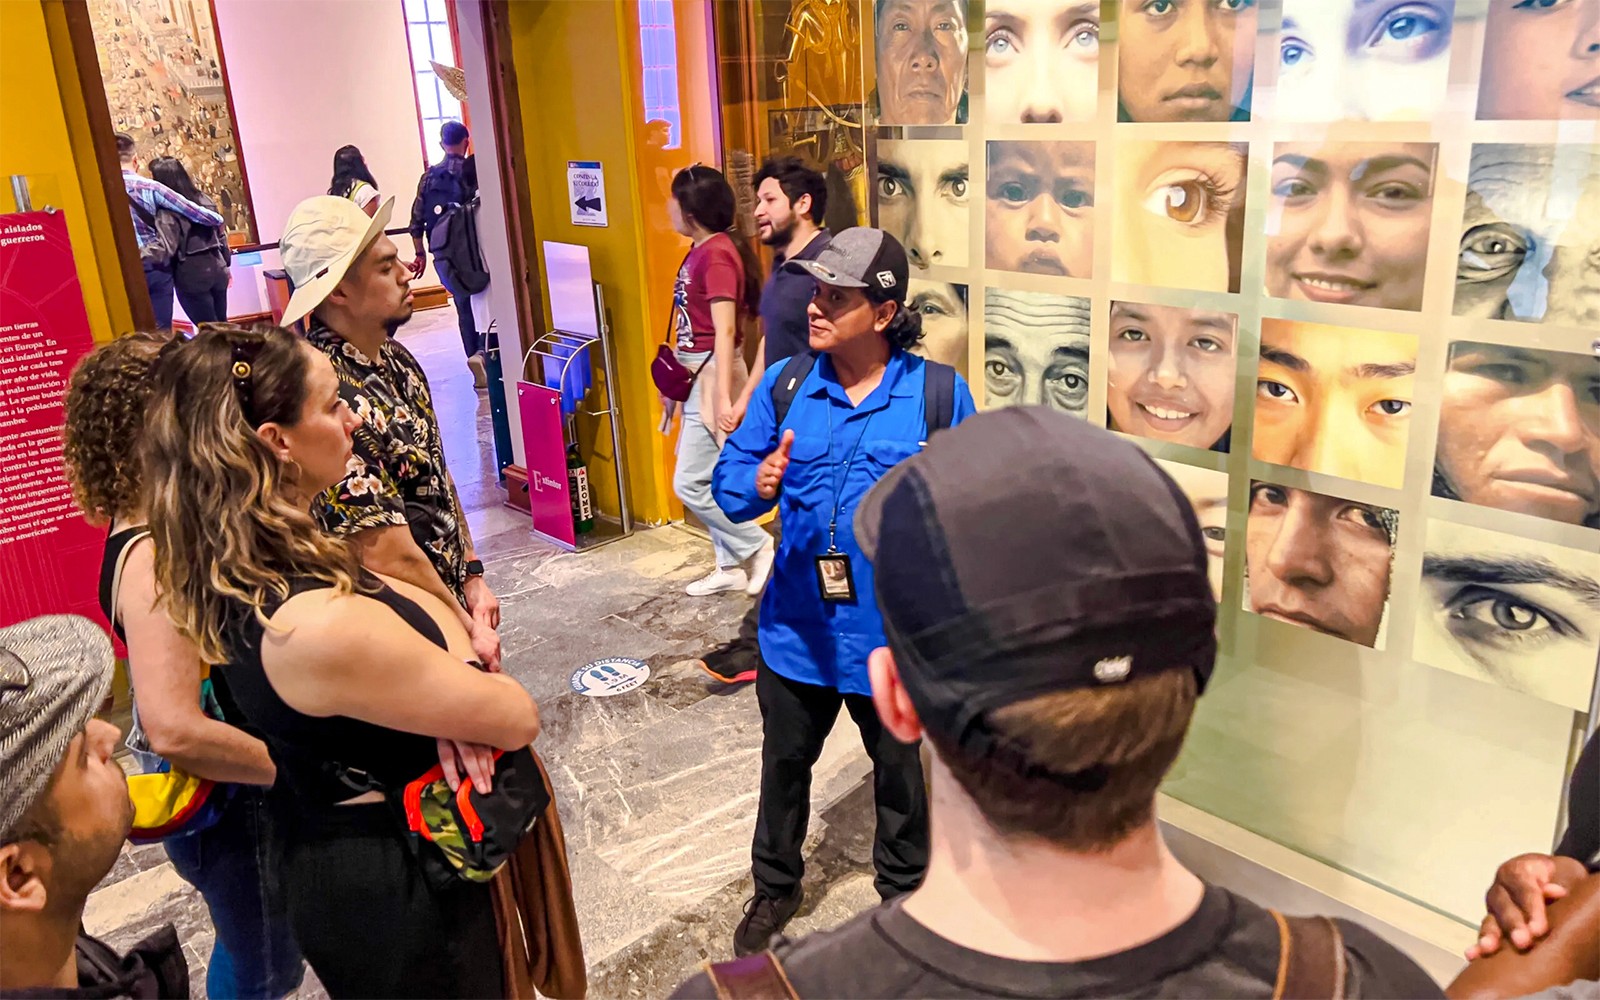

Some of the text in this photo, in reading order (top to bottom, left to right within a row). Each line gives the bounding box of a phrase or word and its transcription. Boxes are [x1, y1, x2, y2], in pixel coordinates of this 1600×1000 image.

[4, 224, 42, 234] aislados
[1, 234, 44, 246] guerreros
[14, 322, 38, 330] tierras
[46, 338, 56, 346] En
[16, 350, 44, 360] infantil
[2, 366, 18, 374] uno
[30, 362, 48, 370] cada
[14, 376, 28, 384] año
[30, 372, 40, 380] de
[6, 386, 24, 394] mala
[26, 380, 60, 392] nutrición
[8, 398, 20, 406] La
[20, 394, 40, 404] peste
[2, 462, 28, 472] contra
[28, 460, 40, 468] los
[20, 470, 36, 480] que
[36, 466, 52, 476] más
[10, 492, 26, 502] vida
[28, 484, 68, 498] imperantes
[4, 496, 60, 514] conquistadores
[12, 508, 46, 522] buscaron
[48, 502, 68, 512] mejor
[18, 522, 32, 530] con
[40, 516, 56, 526] que
